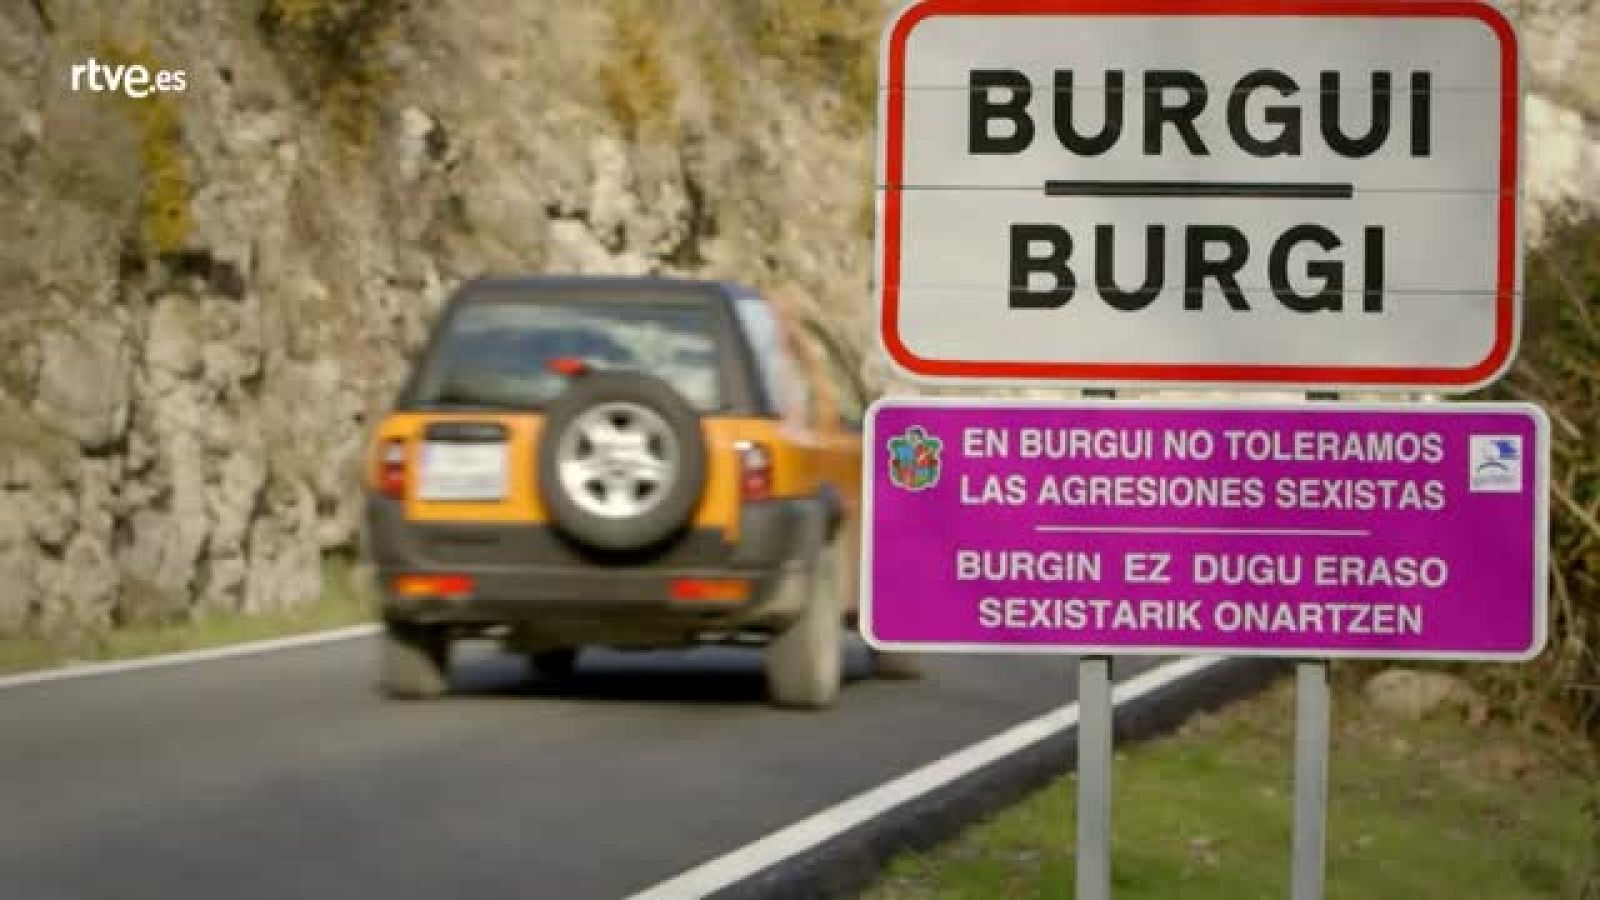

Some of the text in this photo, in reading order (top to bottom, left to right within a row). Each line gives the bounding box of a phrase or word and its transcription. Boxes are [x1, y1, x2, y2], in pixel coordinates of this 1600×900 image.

[968, 69, 1431, 158] BURGUI
[1008, 224, 1384, 313] BURGI
[962, 427, 1443, 463] EN BURGUI NO TOLERAMOS
[961, 474, 1445, 511] LAS AGRESIONES SEXISTAS
[956, 550, 1448, 588] BURGIN EZ DUGU ERASO
[979, 597, 1421, 634] SEXISTARIK ONARTZEN
